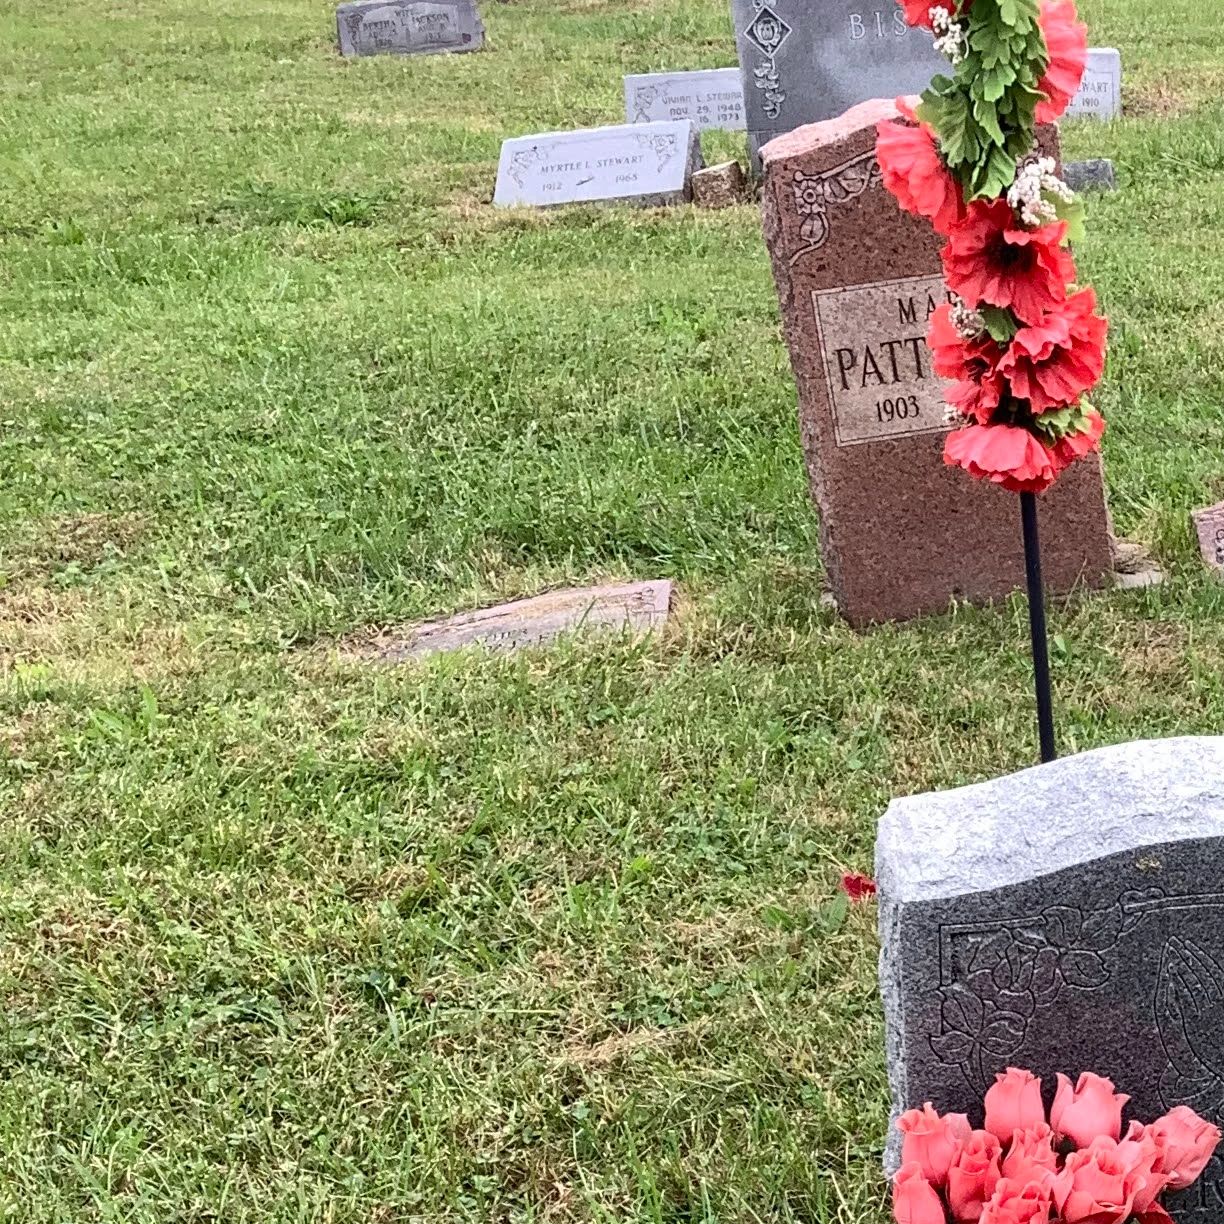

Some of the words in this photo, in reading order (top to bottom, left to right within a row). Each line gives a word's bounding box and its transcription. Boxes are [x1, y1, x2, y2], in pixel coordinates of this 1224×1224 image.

[848, 9, 934, 39] BIS
[707, 91, 742, 101] STEWAR
[540, 160, 582, 174] MYRTLE
[596, 154, 644, 169] STEWART
[875, 395, 920, 423] 1903
